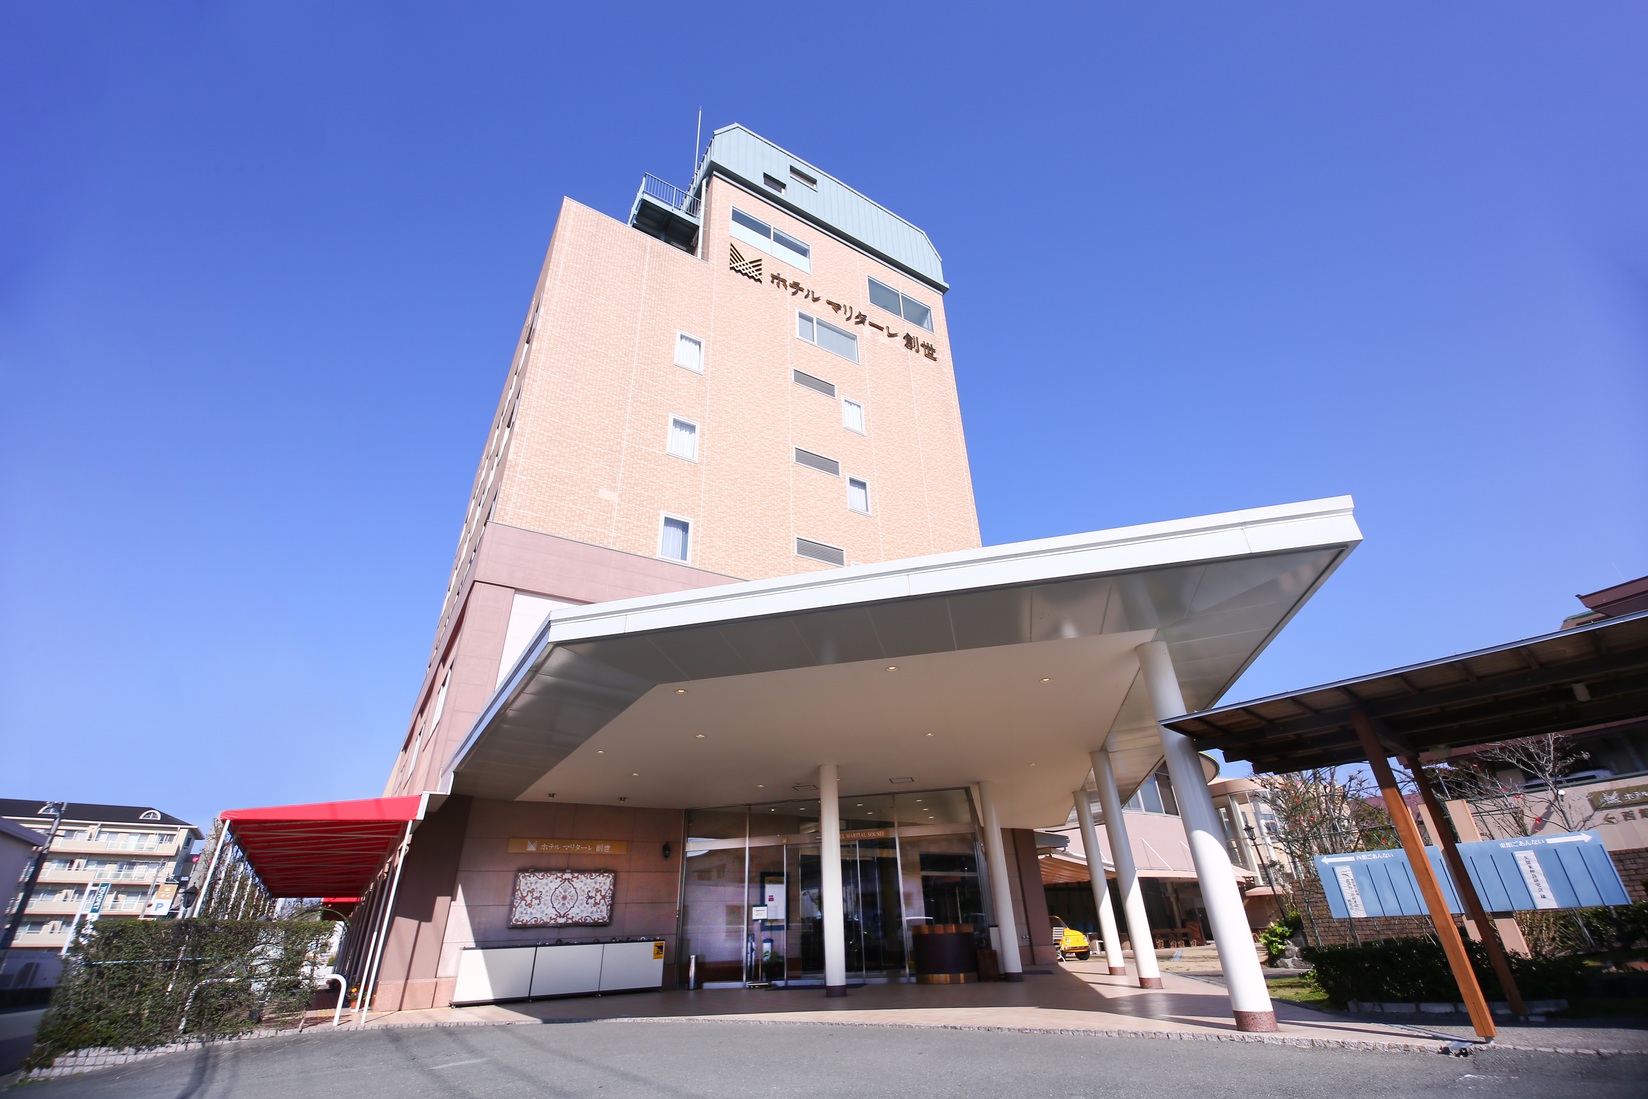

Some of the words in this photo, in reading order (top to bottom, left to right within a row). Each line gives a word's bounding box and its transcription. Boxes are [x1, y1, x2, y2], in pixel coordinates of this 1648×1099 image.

[770, 272, 821, 303] ホテル
[826, 298, 899, 338] マリターレ
[903, 332, 938, 362] 創世
[540, 842, 560, 851] ホテル
[562, 843, 593, 852] マリターレ
[595, 844, 611, 853] 創世
[154, 902, 164, 912] P
